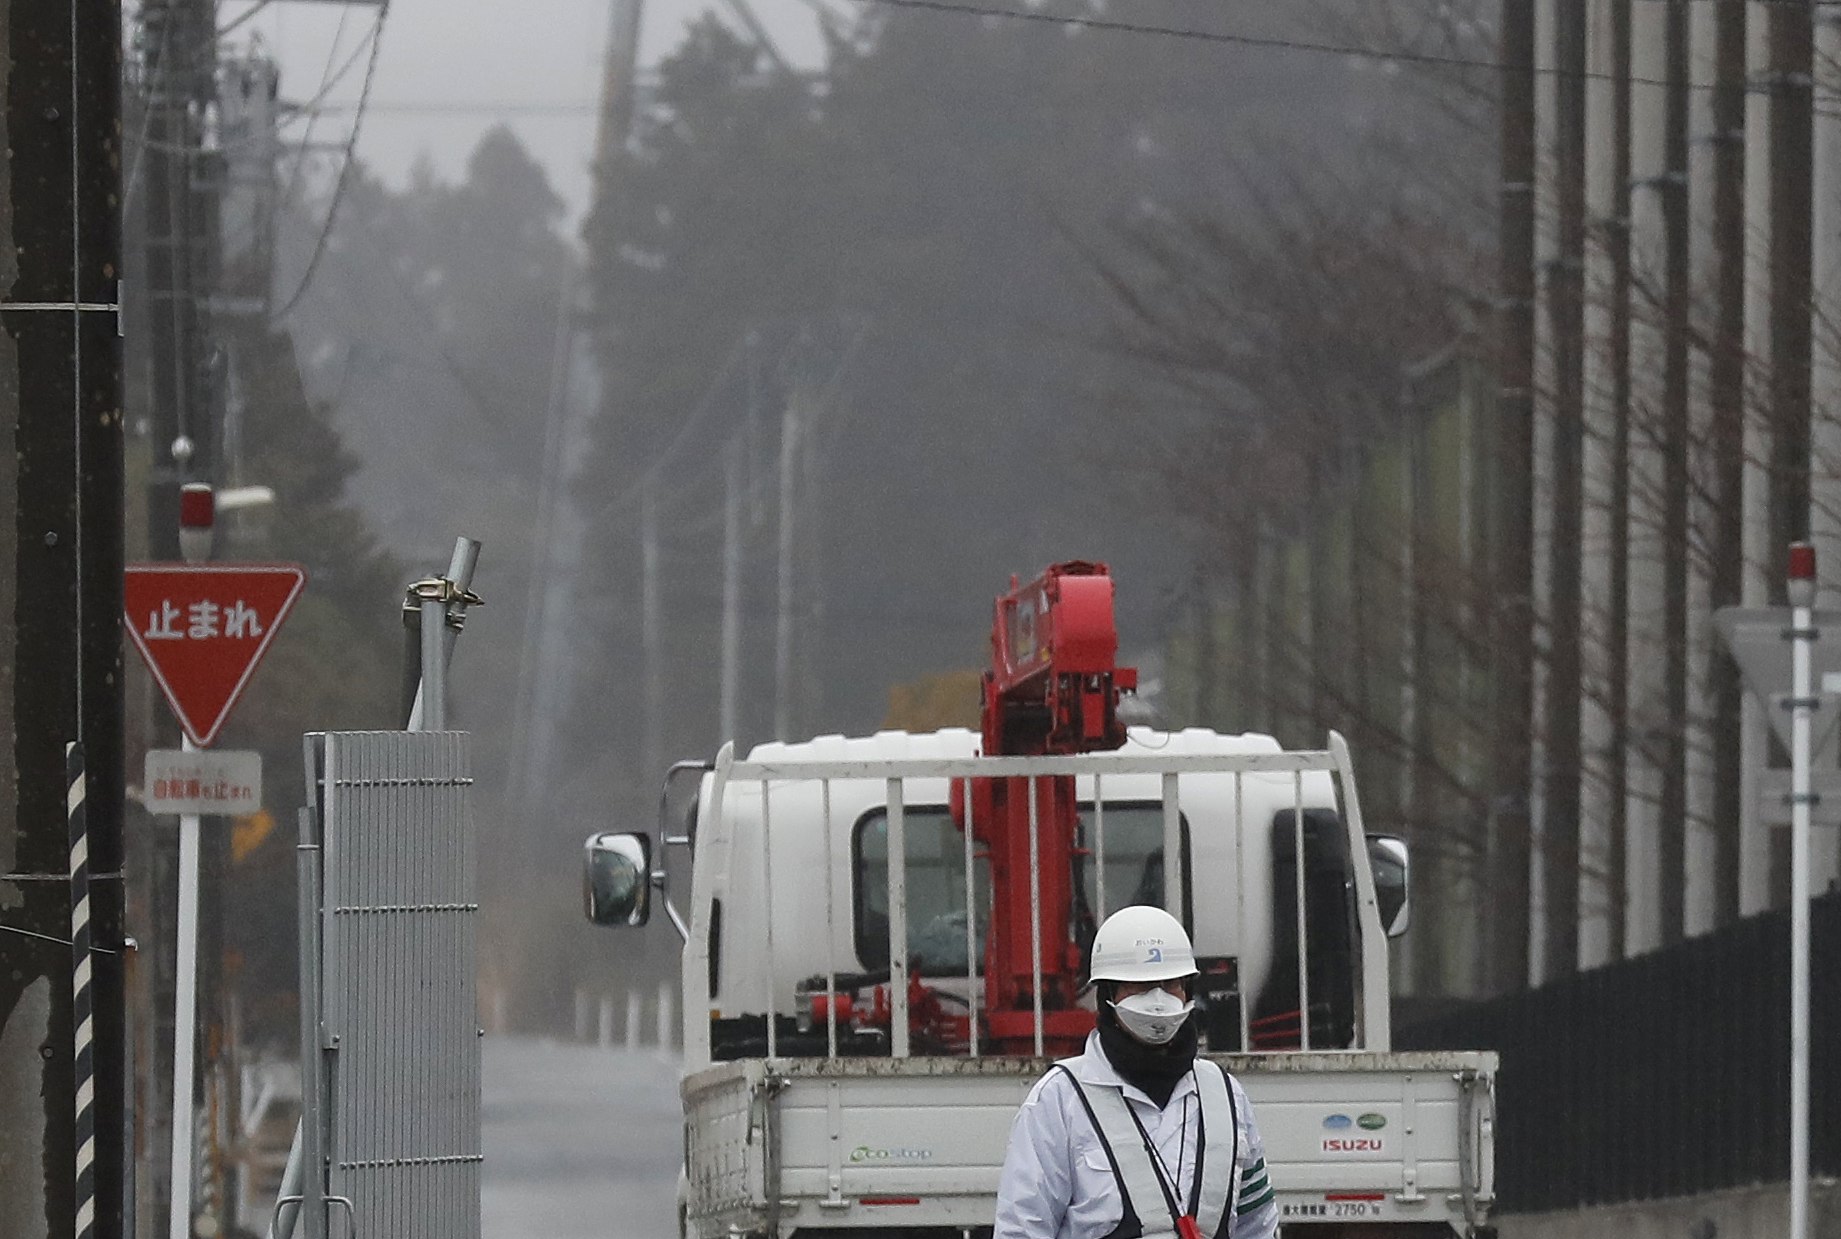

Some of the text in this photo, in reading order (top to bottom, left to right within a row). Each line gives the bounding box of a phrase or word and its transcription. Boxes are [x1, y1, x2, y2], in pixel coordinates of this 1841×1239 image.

[144, 599, 263, 639] 止まれ
[1323, 1139, 1382, 1151] ISUZU
[1335, 1203, 1365, 1216] 2750
